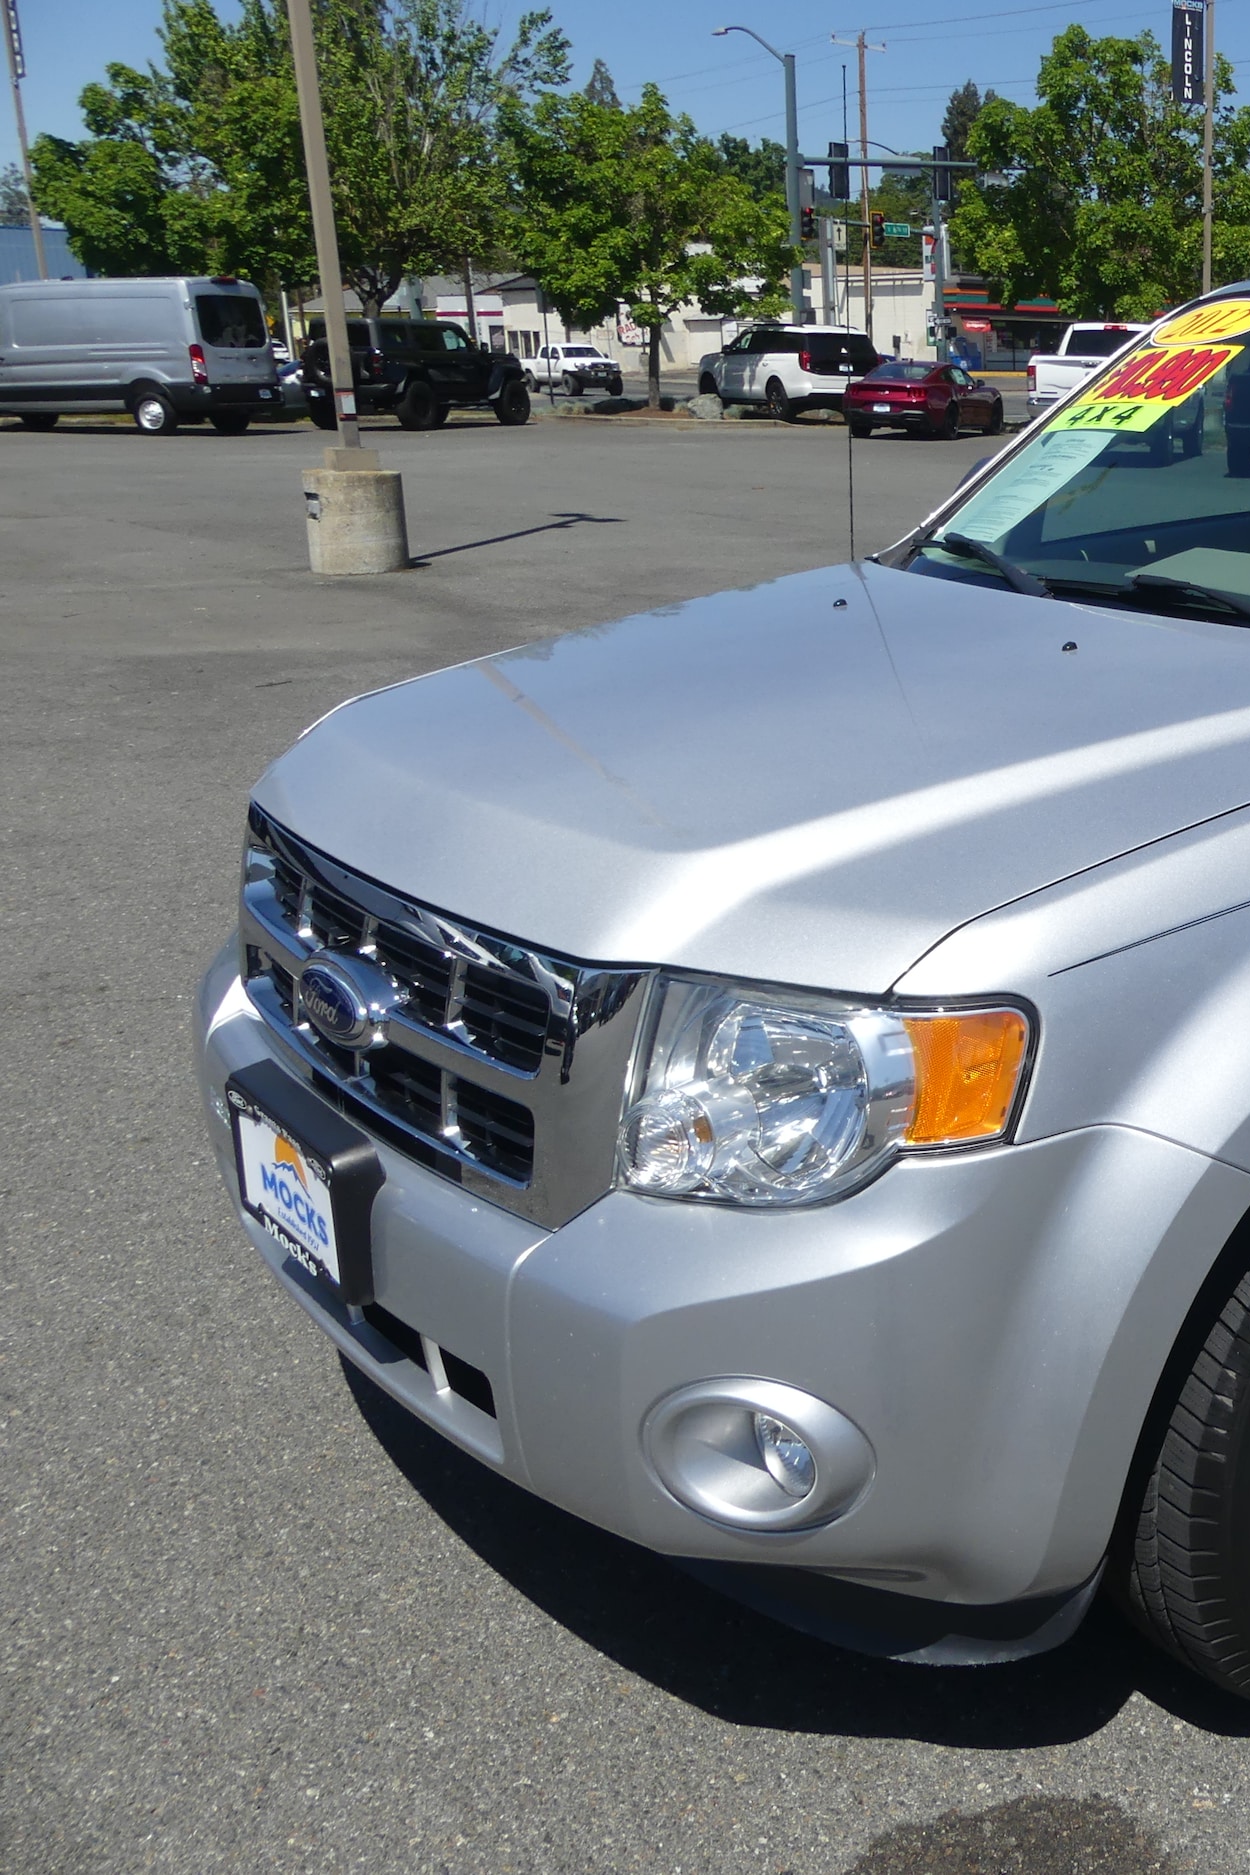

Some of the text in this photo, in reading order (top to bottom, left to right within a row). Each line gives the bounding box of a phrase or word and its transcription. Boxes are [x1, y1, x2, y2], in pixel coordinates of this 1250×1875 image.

[1184, 13, 1193, 99] LINCOLN
[1093, 348, 1232, 400] $10,990
[304, 977, 341, 1025] Ford
[260, 1163, 329, 1247] MOCKS
[264, 1215, 318, 1277] Mock's
